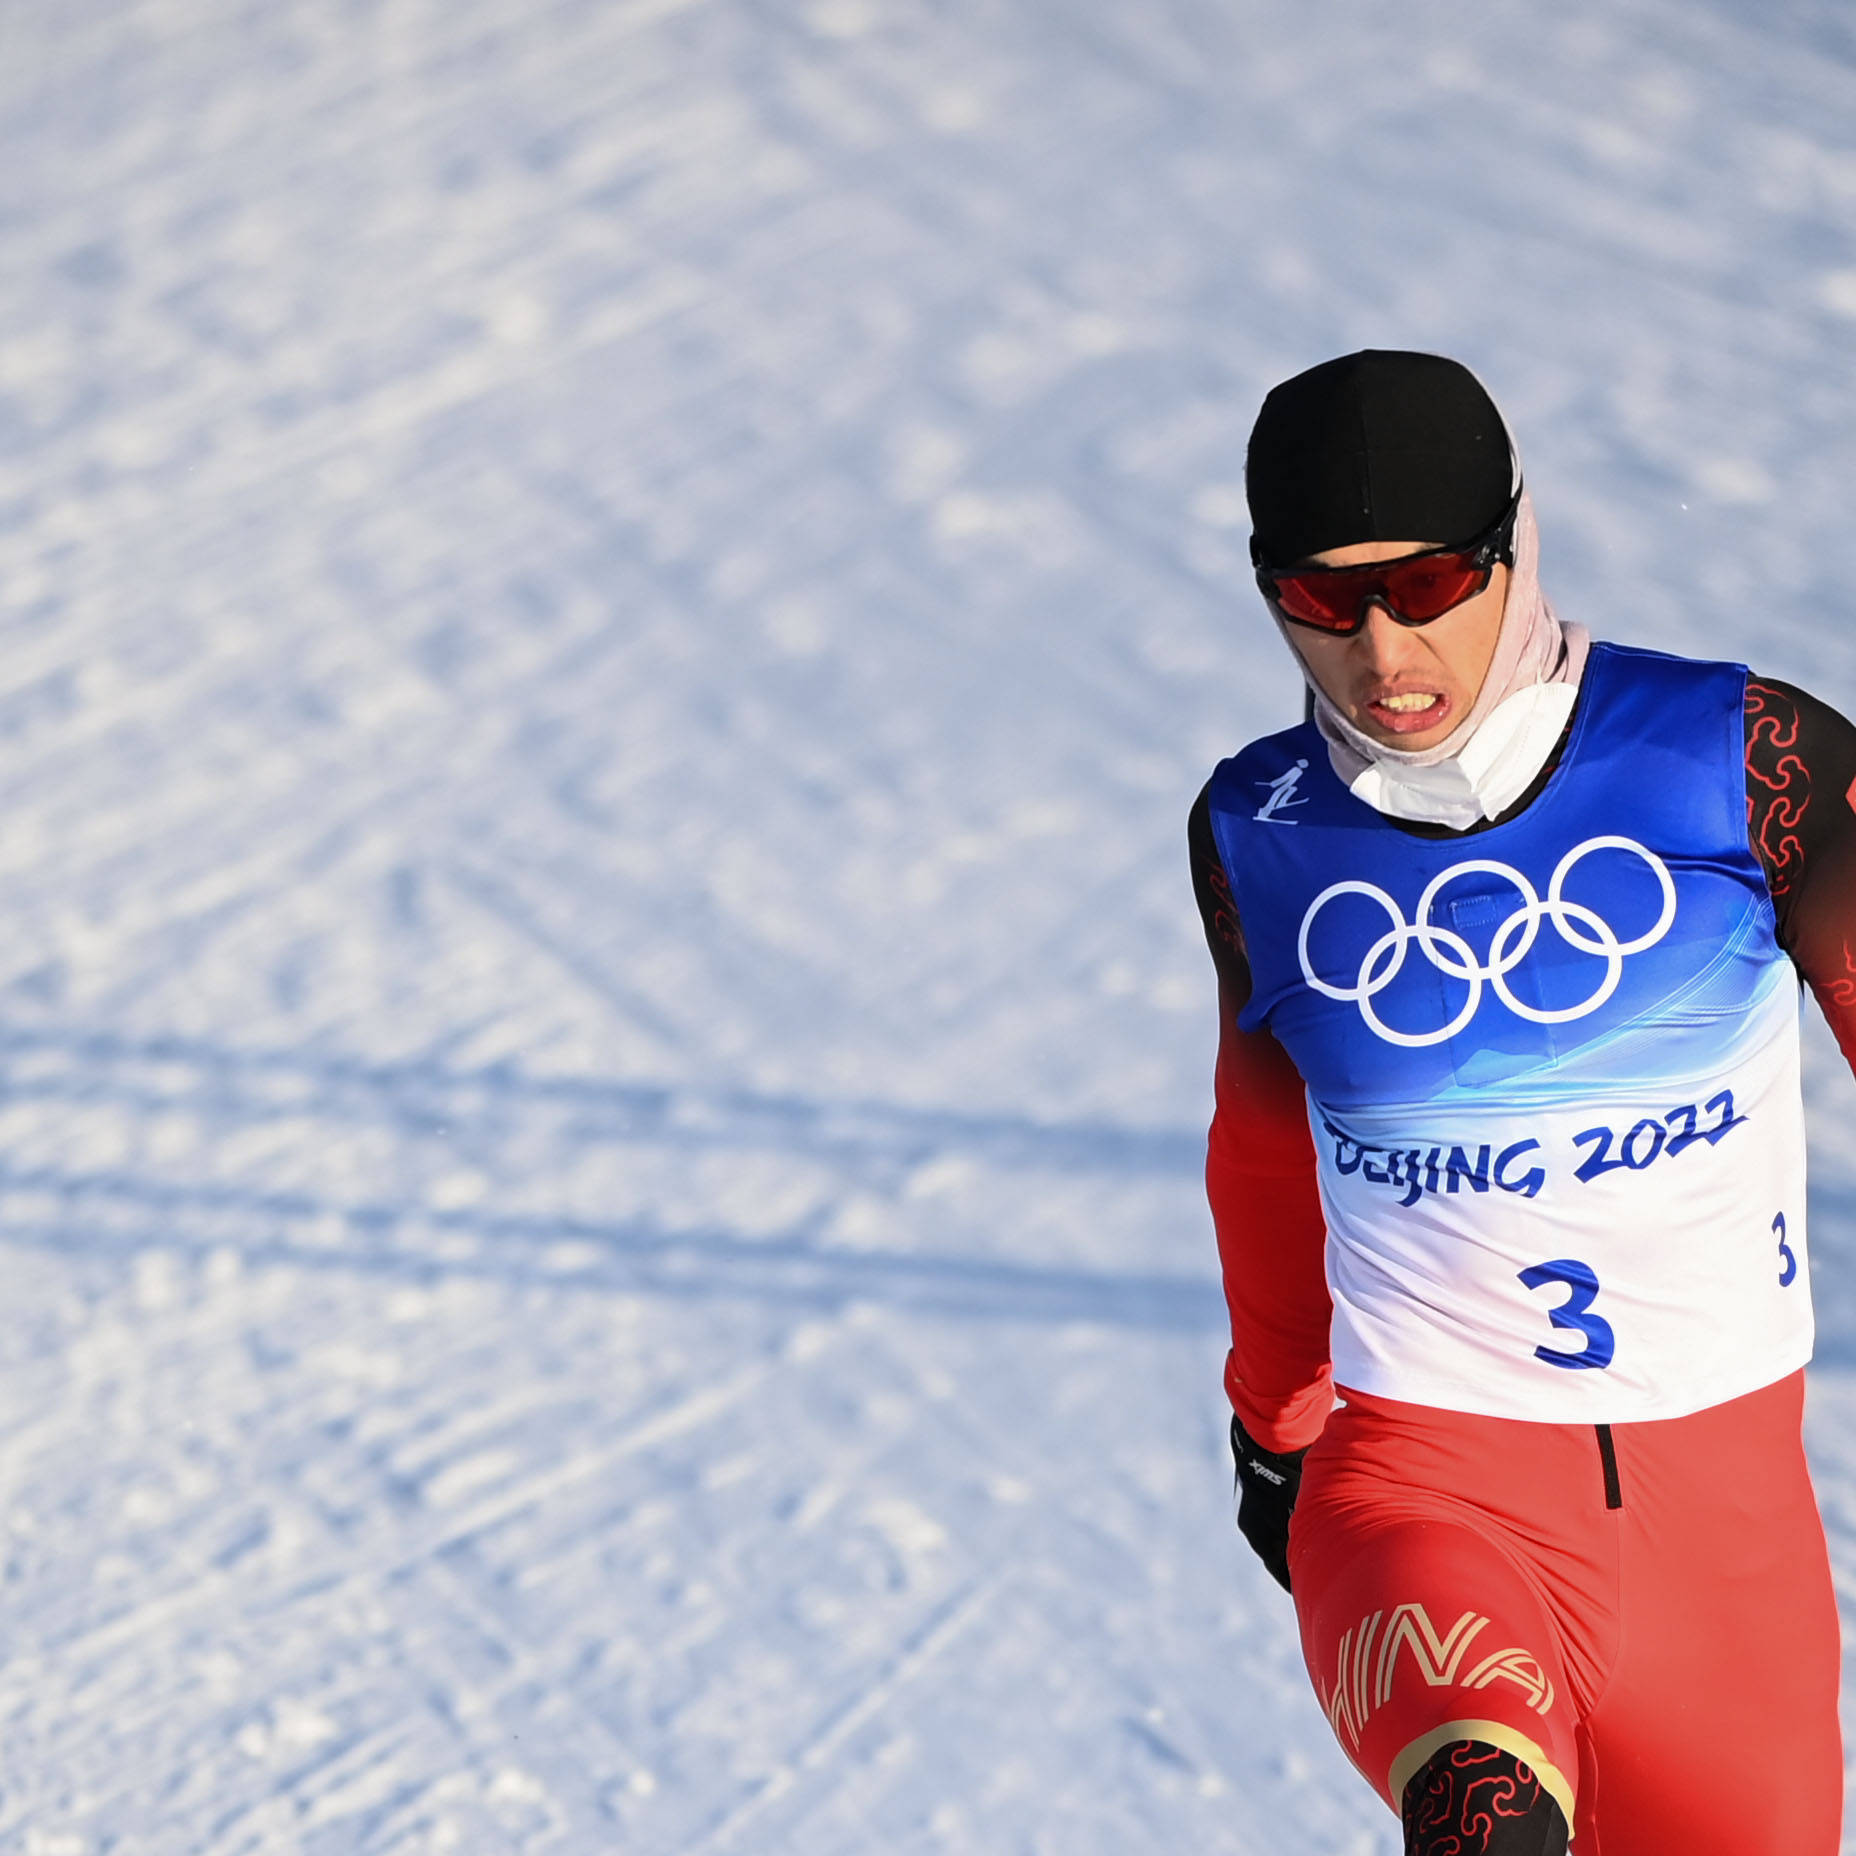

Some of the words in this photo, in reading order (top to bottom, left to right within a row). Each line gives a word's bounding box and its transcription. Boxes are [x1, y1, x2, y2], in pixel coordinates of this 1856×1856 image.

[1323, 1120, 1545, 1208] BEIJING
[1572, 1088, 1751, 1185] 2022
[1771, 1210, 1797, 1288] 3
[1516, 1258, 1616, 1370] 3
[1322, 1602, 1556, 1754] HINA
